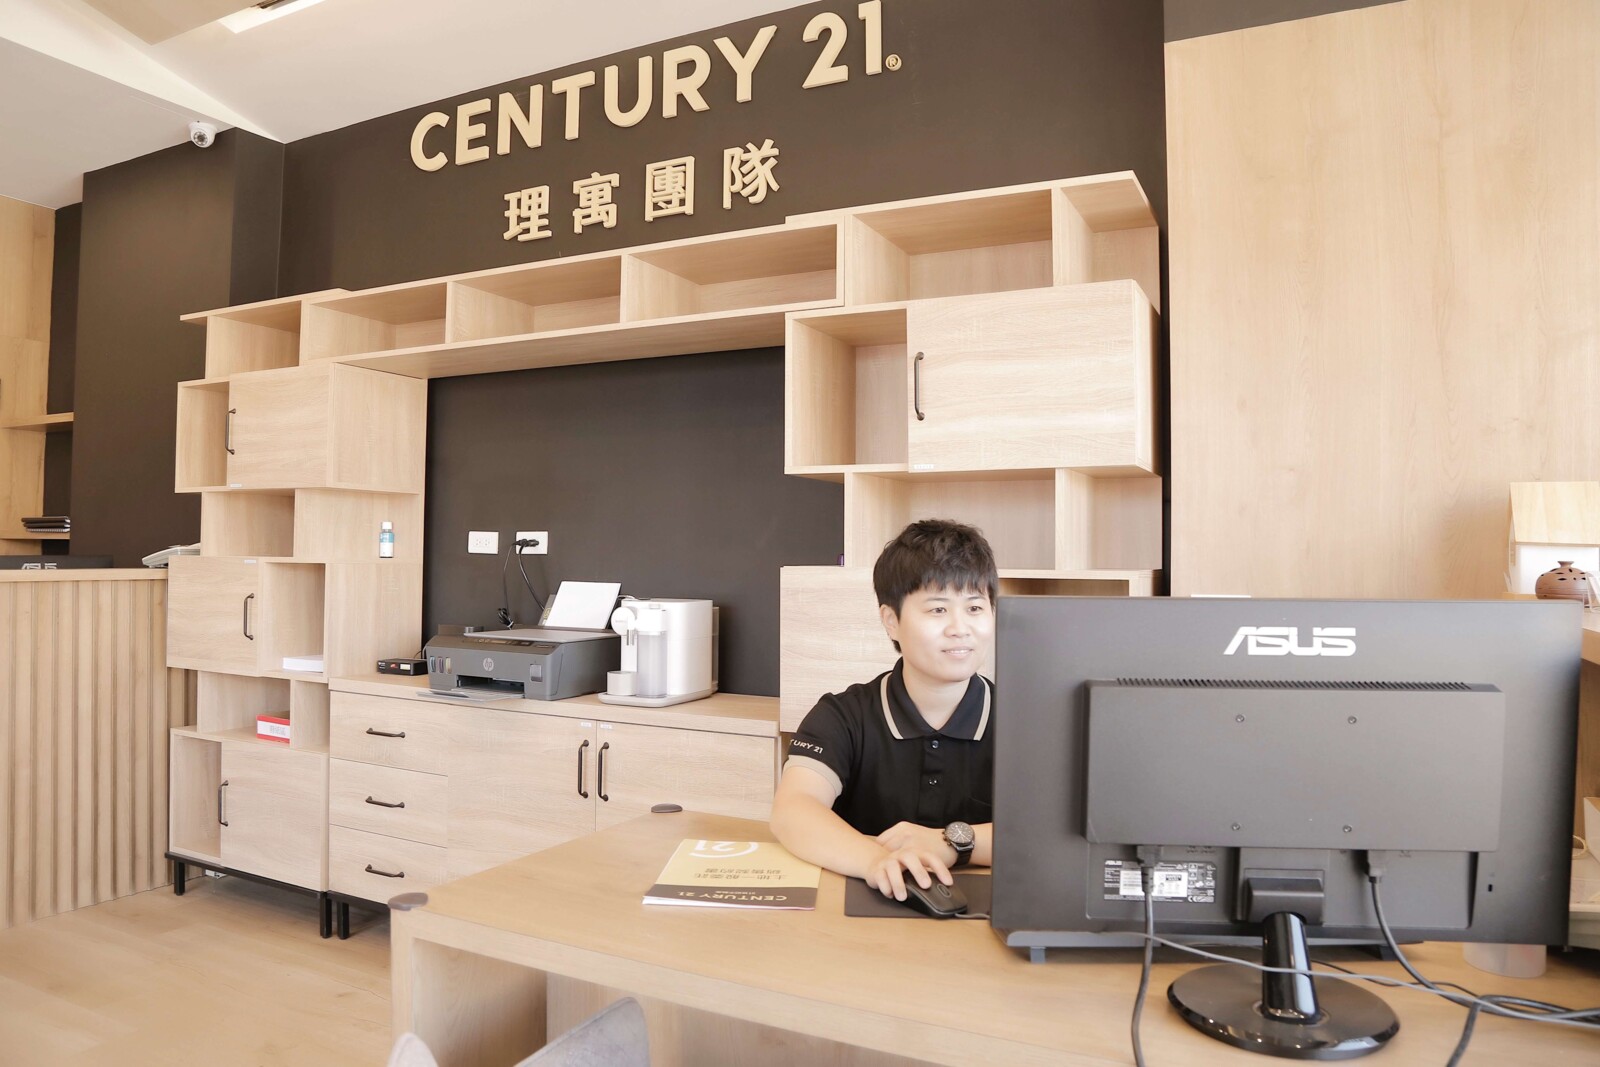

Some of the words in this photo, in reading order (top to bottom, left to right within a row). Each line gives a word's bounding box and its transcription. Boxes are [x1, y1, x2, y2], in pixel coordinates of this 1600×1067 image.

[409, 25, 778, 172] CENTURY
[502, 138, 781, 242] 理寓團隊
[1223, 626, 1357, 657] ASUS
[813, 746, 824, 754] 21
[698, 893, 788, 901] CENTURY
